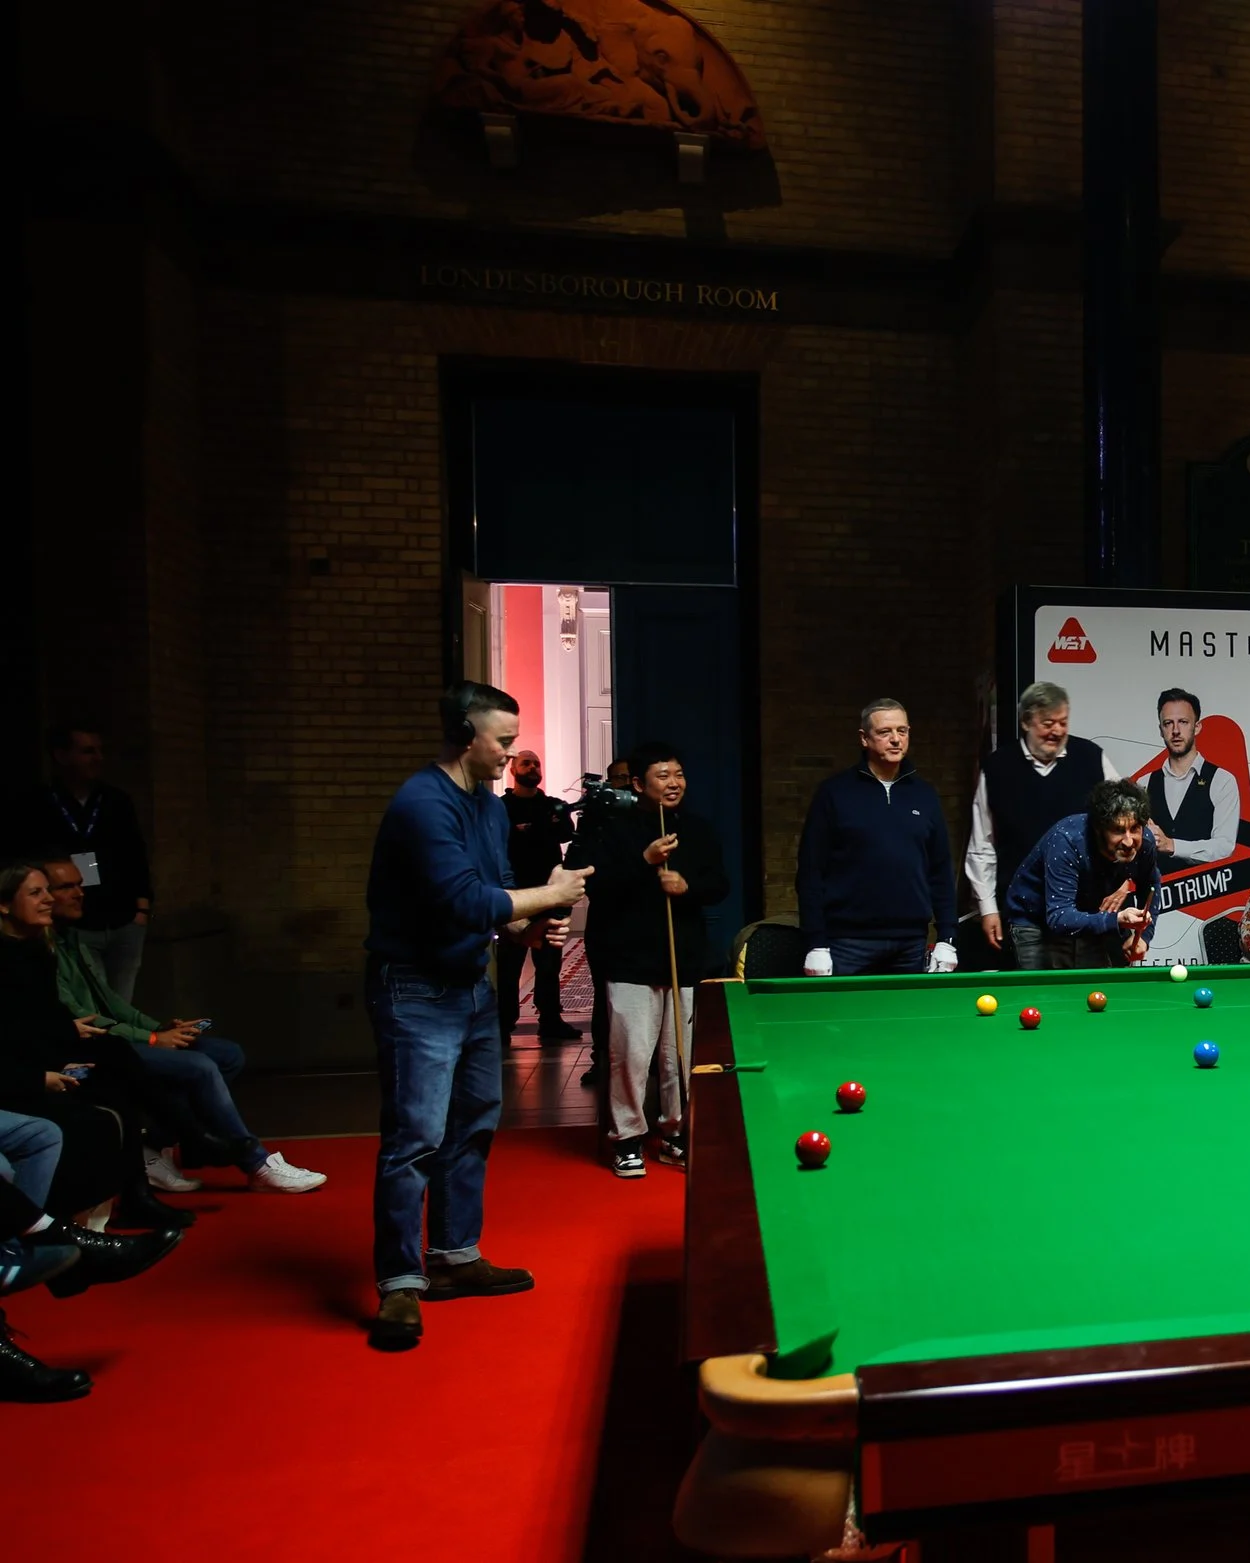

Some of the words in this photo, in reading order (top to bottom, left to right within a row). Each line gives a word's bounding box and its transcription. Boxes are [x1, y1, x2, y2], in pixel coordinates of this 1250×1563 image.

[420, 264, 684, 303] LONDESBOROUGH
[697, 284, 779, 312] ROOM
[1174, 868, 1233, 905] TRUMP
